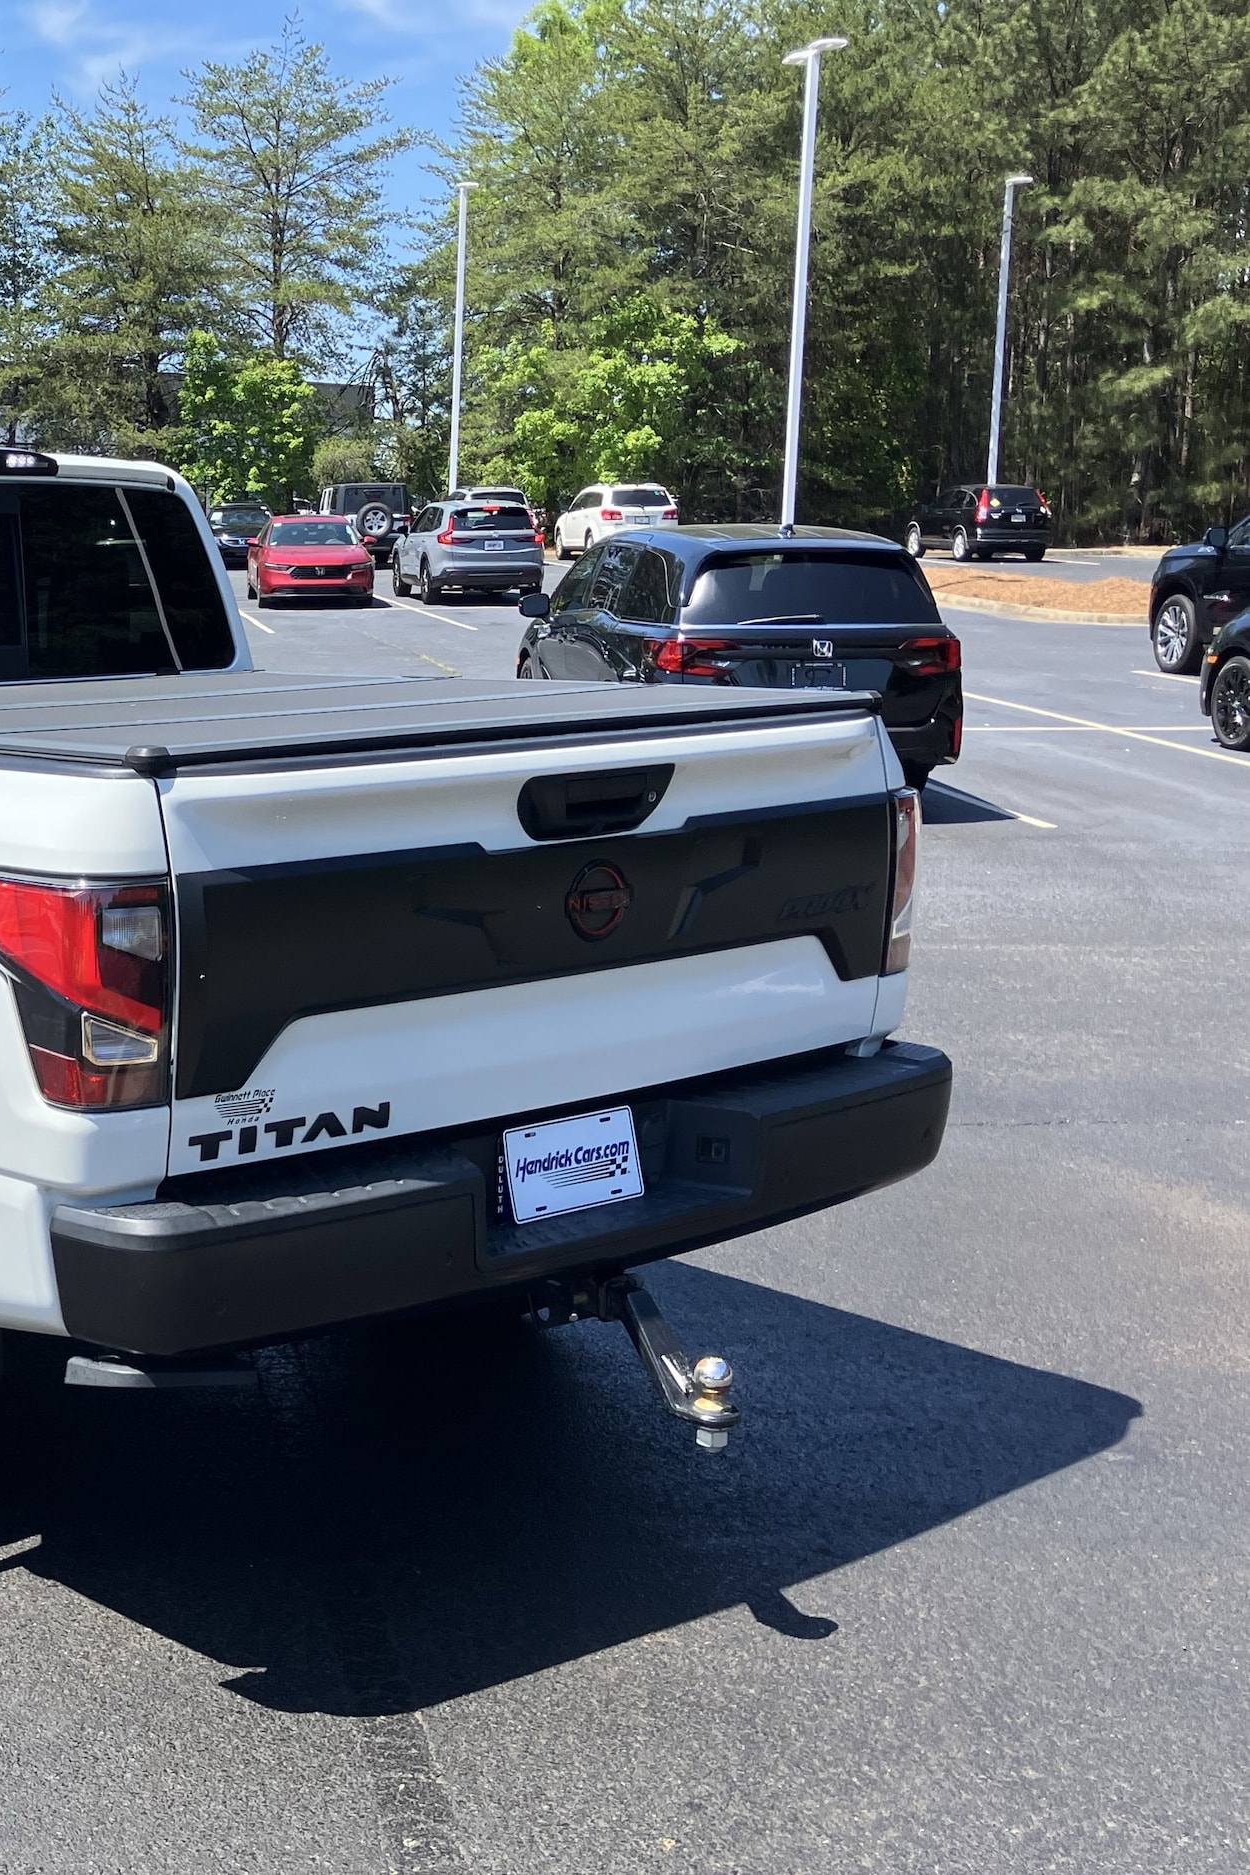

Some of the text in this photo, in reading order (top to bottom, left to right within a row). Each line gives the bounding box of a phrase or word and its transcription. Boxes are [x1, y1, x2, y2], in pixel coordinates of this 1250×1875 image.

[214, 1088, 276, 1103] Gwinnett Place
[188, 1101, 390, 1162] TITAN
[226, 1116, 260, 1126] Honda
[496, 1155, 505, 1214] DULUTH
